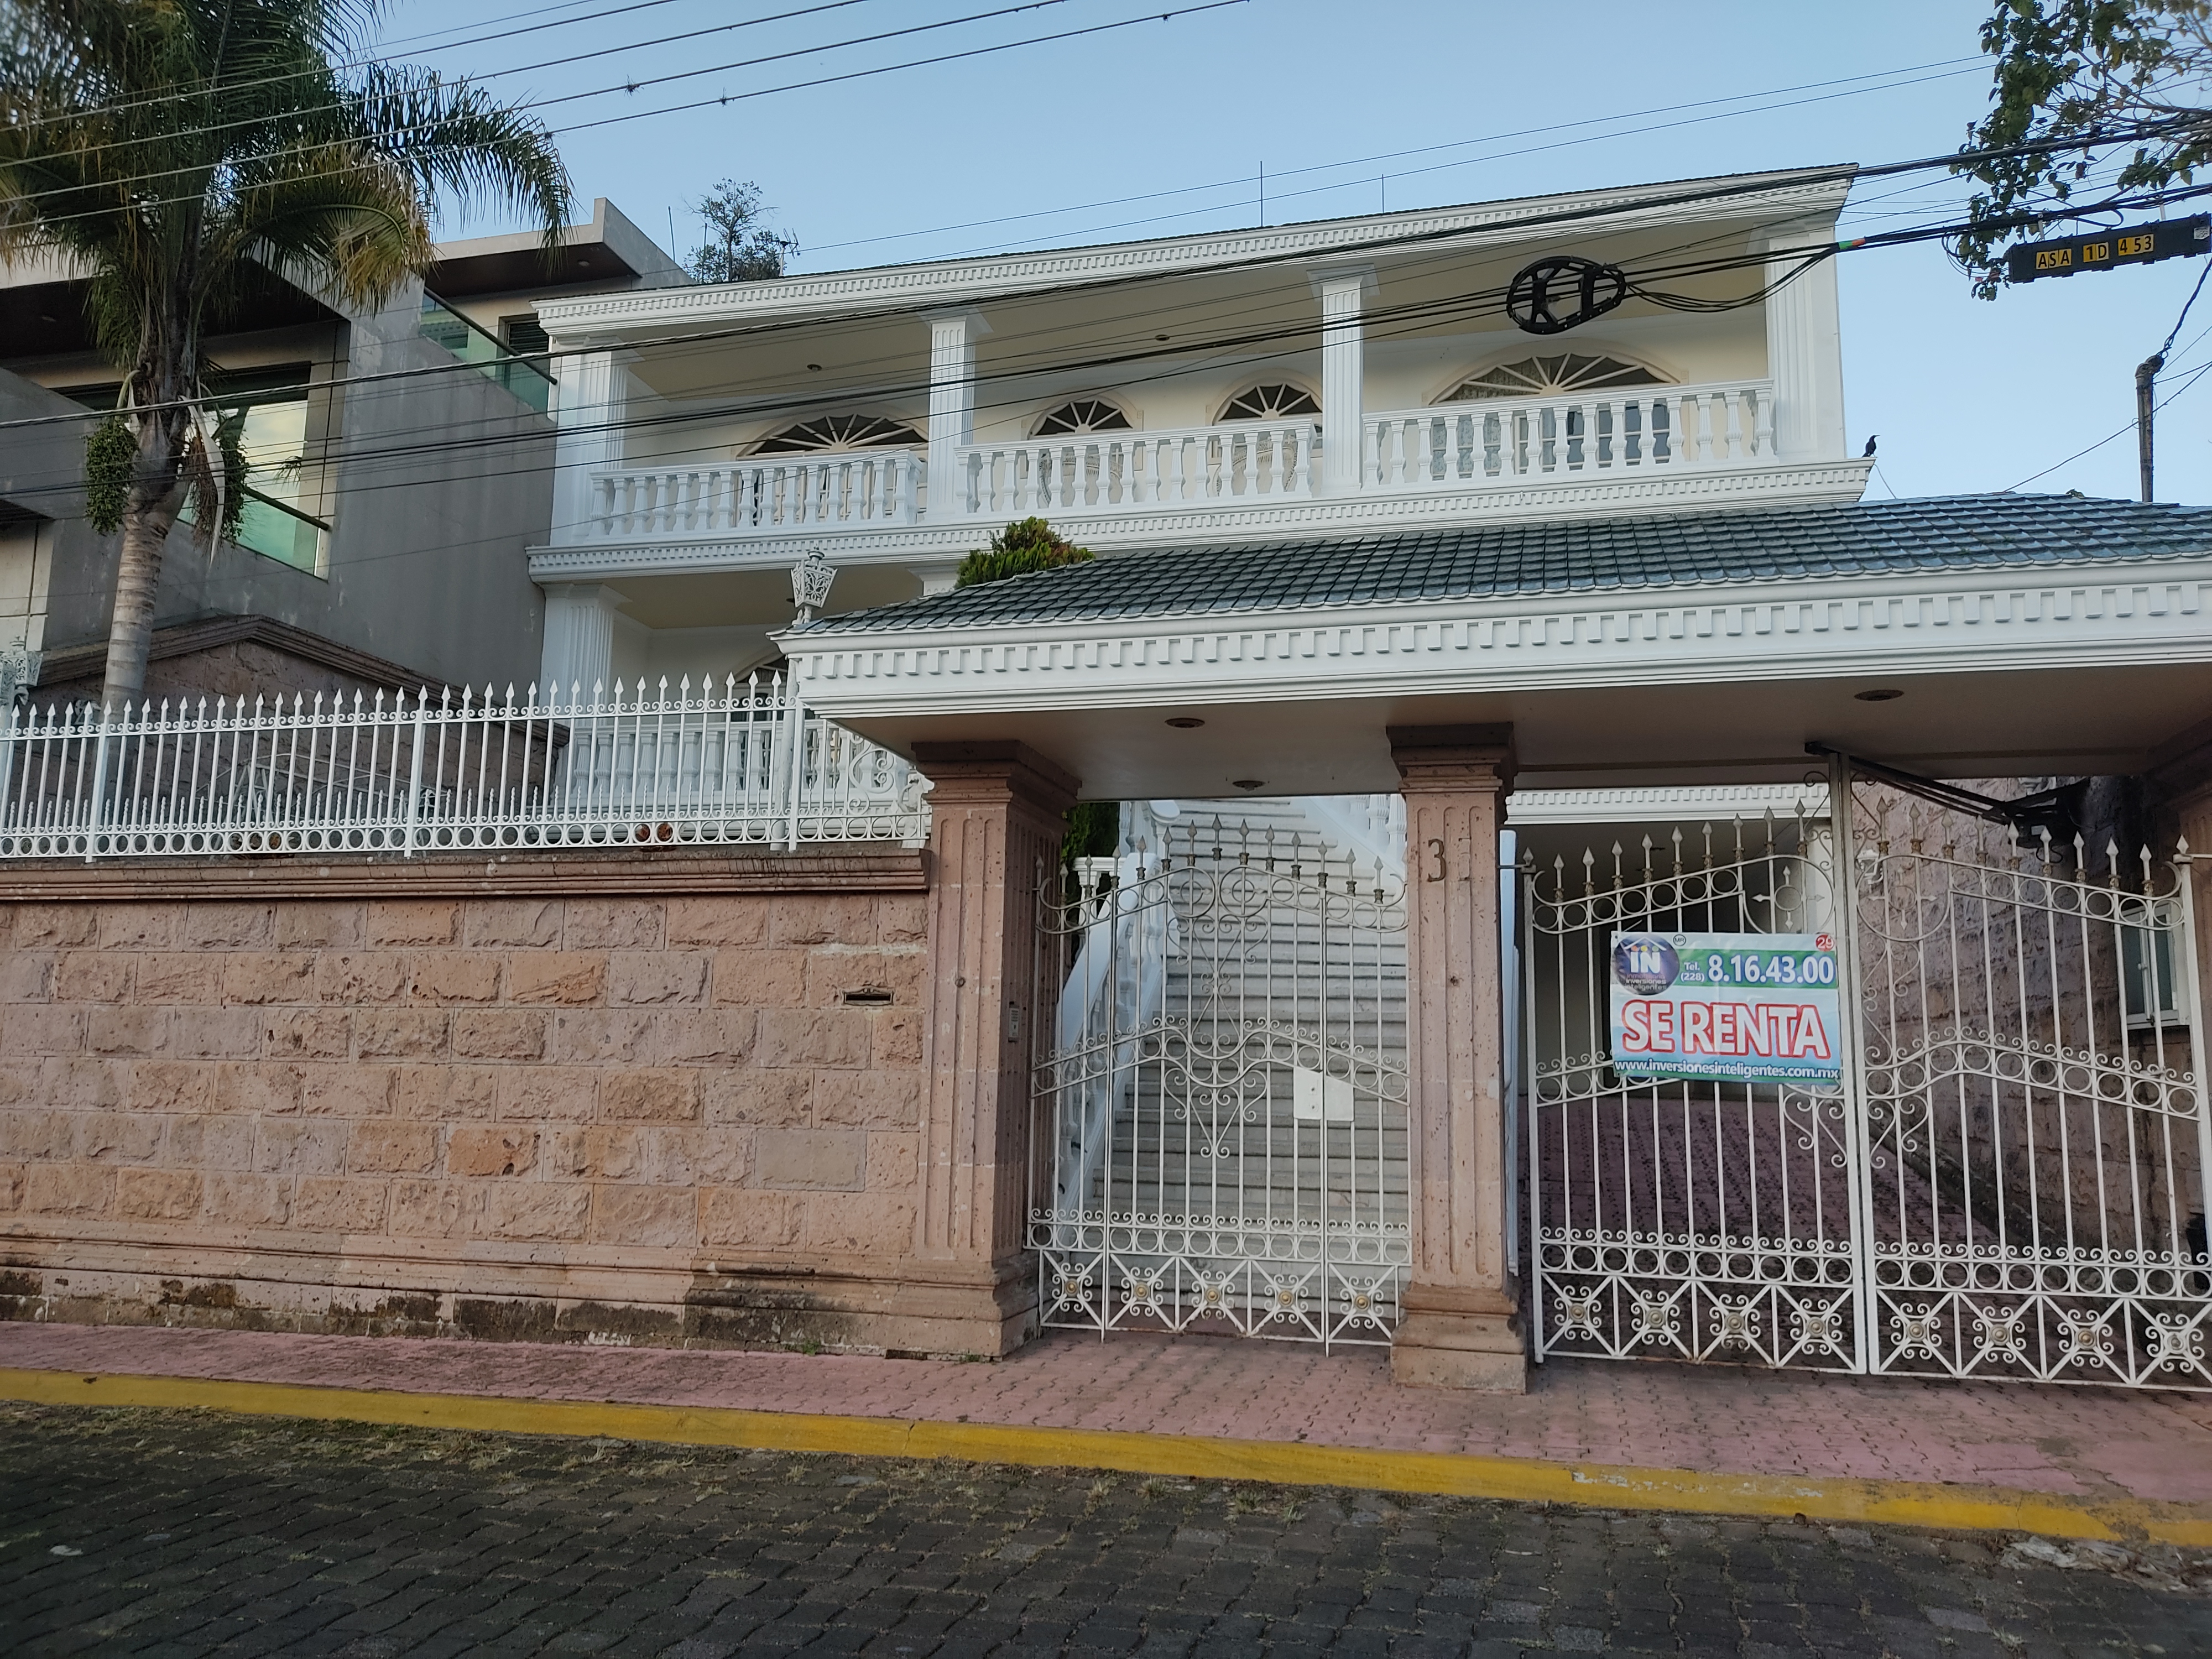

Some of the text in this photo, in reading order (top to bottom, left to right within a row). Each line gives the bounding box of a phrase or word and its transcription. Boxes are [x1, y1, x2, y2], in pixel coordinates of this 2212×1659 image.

[2038, 236, 2152, 268] ASA 1D 453
[1817, 936, 1834, 949] 29
[1681, 954, 1834, 984] (228) 8.16.43.00
[1684, 962, 1700, 971] Tel.
[1623, 1000, 1830, 1058] SE RENTA
[1615, 1058, 1838, 1078] www.inversionesinteligentes.com.mx
